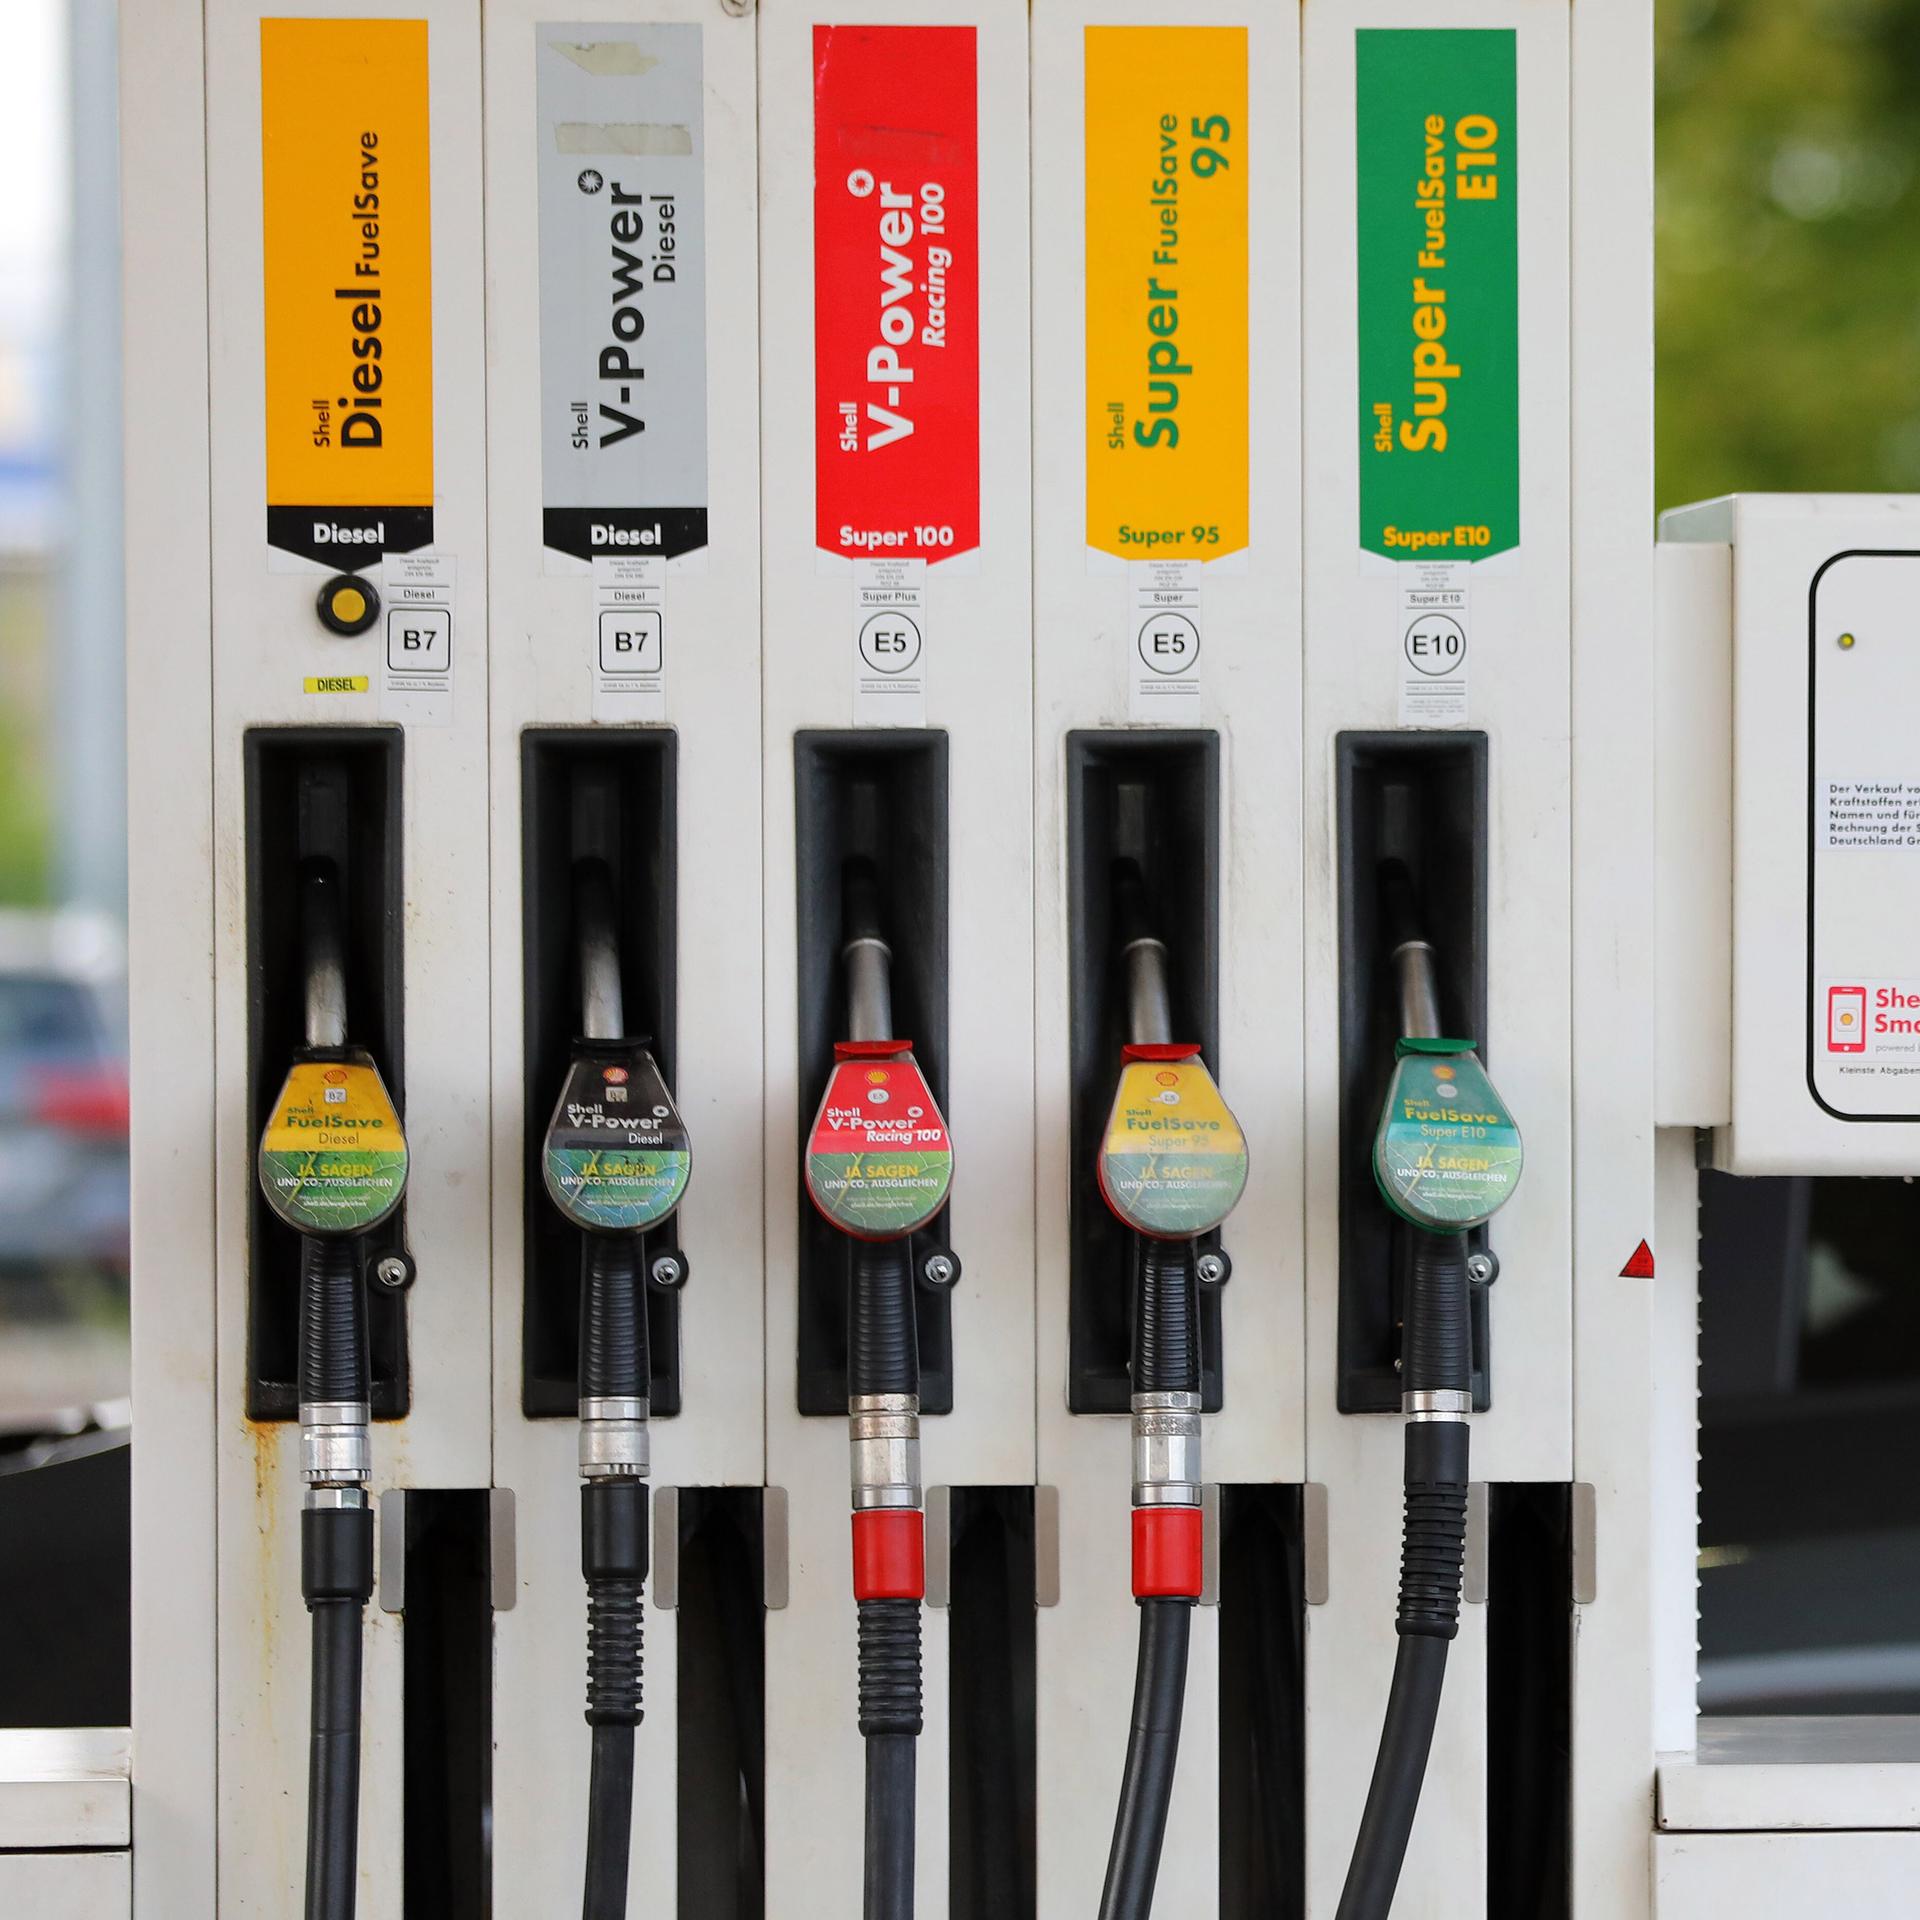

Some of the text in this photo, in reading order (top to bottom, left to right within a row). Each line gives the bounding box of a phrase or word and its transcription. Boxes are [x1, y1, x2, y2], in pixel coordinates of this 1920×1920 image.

[1190, 115, 1230, 179] 95
[1455, 114, 1499, 200] E10
[650, 195, 676, 283] Diesel
[920, 182, 952, 348] Racing 100
[1134, 114, 1193, 450] Super FuelSave
[1400, 113, 1462, 452] Super FuelSave
[335, 131, 383, 448] Diesel FuelSave
[599, 182, 646, 449] V-Power
[867, 182, 914, 452] V-Power
[313, 400, 331, 447] Shell
[571, 402, 589, 449] Shell
[839, 402, 858, 452] Shell
[1107, 402, 1125, 449] Shell
[1374, 403, 1392, 452] Shell
[313, 522, 385, 544] Diesel
[591, 523, 662, 546] Diesel
[839, 525, 954, 551] Super 100
[1118, 525, 1220, 549] Super 95
[1383, 525, 1491, 551] Super E10
[403, 590, 435, 600] Diesel
[614, 591, 645, 601] Diesel
[862, 592, 917, 603] Super Plus
[1153, 593, 1183, 604] Super
[1410, 594, 1461, 605] Super E10
[403, 630, 436, 651] B7
[615, 632, 648, 652] B7
[874, 632, 907, 653] E5
[1154, 633, 1185, 654] E5
[1413, 635, 1458, 655] E10
[317, 679, 355, 691] DIESEL
[1830, 784, 1850, 793] Der
[1855, 784, 1902, 793] Verkauf
[1830, 797, 1902, 807] Kraftstoffen
[1830, 810, 1920, 820] Namen und für
[1830, 822, 1888, 835] Rechnung
[1892, 823, 1911, 832] der
[1830, 836, 1902, 845] Deutschland
[1876, 987, 1920, 1009] She
[1875, 1045, 1915, 1055] powered
[1839, 1066, 1876, 1074] Kleinste
[567, 1104, 603, 1115] Shell
[827, 1107, 861, 1117] Shell
[1405, 1107, 1498, 1124] FuelSave
[287, 1116, 384, 1129] FuelSave
[568, 1114, 663, 1130] V-Power
[828, 1118, 917, 1131] V-Power
[1127, 1117, 1220, 1131] FuelSave
[318, 1132, 360, 1145] Diesel
[628, 1132, 663, 1145] Diesel
[866, 1130, 941, 1144] Racing 100
[1421, 1124, 1486, 1141] Super E10
[1149, 1135, 1186, 1149] Super
[297, 1164, 373, 1177] JA SAGEN
[580, 1164, 601, 1176] JA
[1416, 1156, 1489, 1171] JA SAGEN
[844, 1165, 919, 1178] JA SAGEN
[1140, 1167, 1157, 1180] JA
[1397, 1168, 1418, 1177] UND
[1442, 1171, 1507, 1183] AUSGLEICHEN
[277, 1178, 300, 1187] UND
[324, 1178, 393, 1187] AUSGLEICHEN
[561, 1177, 584, 1186] UND
[825, 1180, 848, 1189] UND
[871, 1179, 938, 1188] AUSGLEICHEN
[1120, 1180, 1143, 1189] UND
